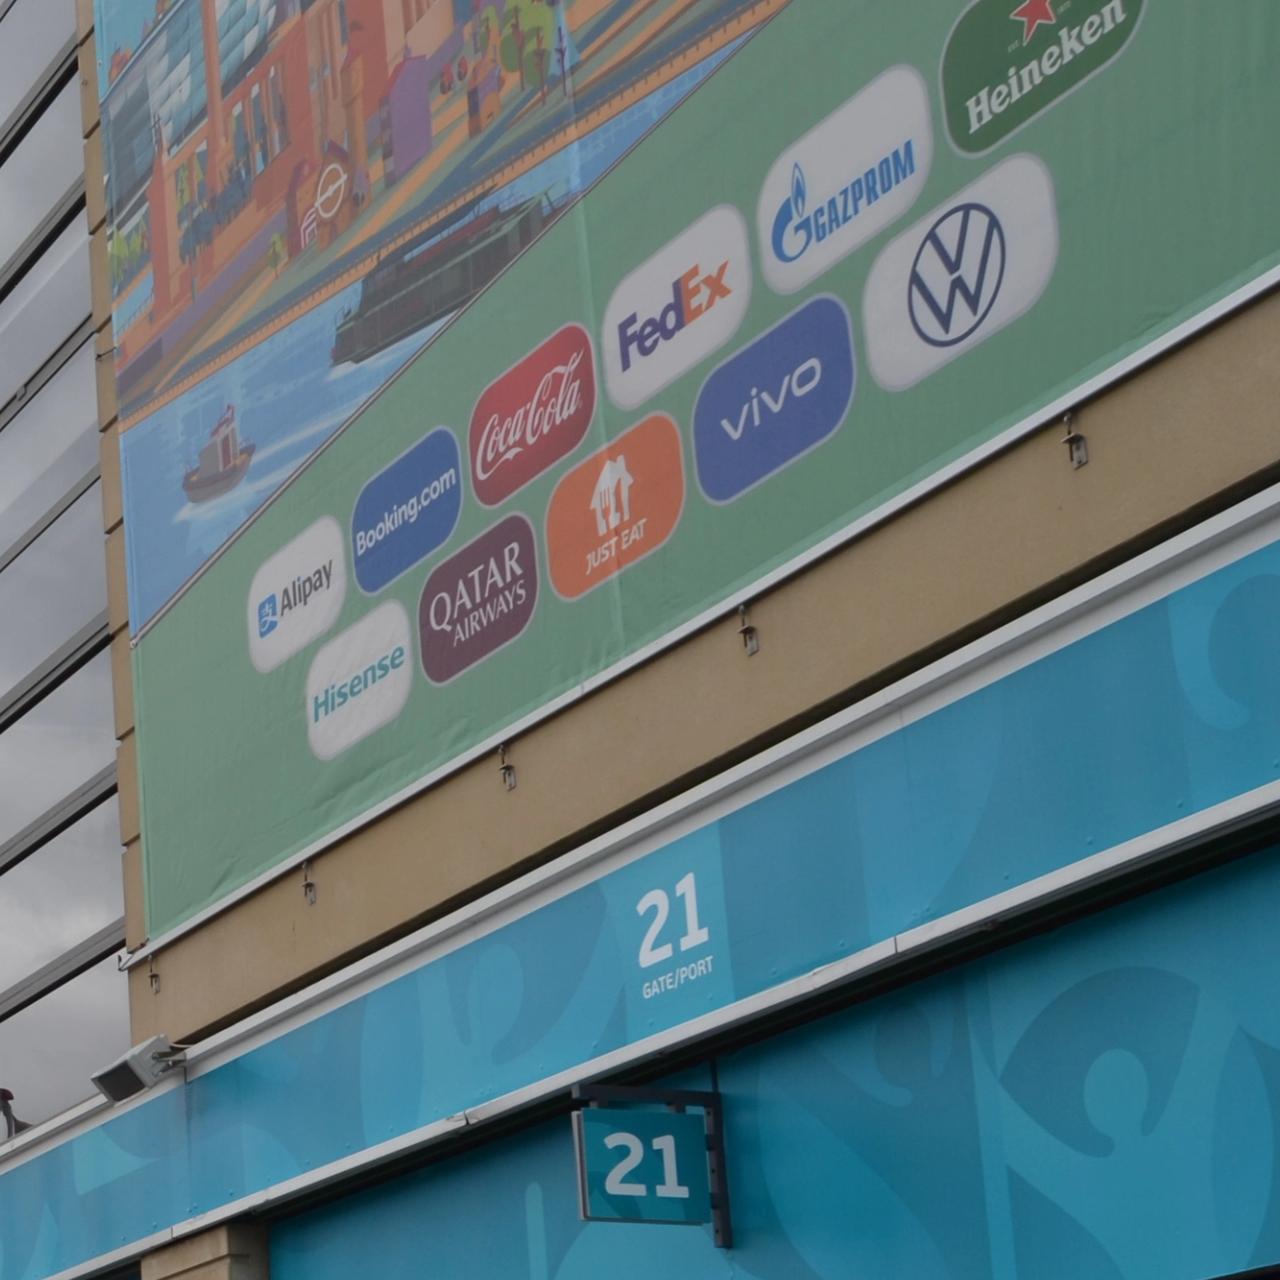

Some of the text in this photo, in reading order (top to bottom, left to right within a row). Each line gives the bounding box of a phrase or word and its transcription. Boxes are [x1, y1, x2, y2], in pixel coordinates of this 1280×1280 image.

[965, 0, 1127, 135] Heineken
[812, 138, 916, 244] GAZPROM
[617, 259, 733, 373] FedEx
[475, 348, 585, 481] Coca-Cola
[720, 357, 822, 441] vivo
[355, 467, 456, 557] Booking.com
[585, 518, 647, 576] JUST EAT
[280, 559, 333, 617] Alipay
[429, 541, 524, 633] QATAR
[453, 579, 527, 647] AIRWAYS
[313, 646, 405, 723] Hisense
[635, 871, 710, 969] 21
[642, 955, 714, 1000] GATE/PORT
[603, 1131, 690, 1199] 21
